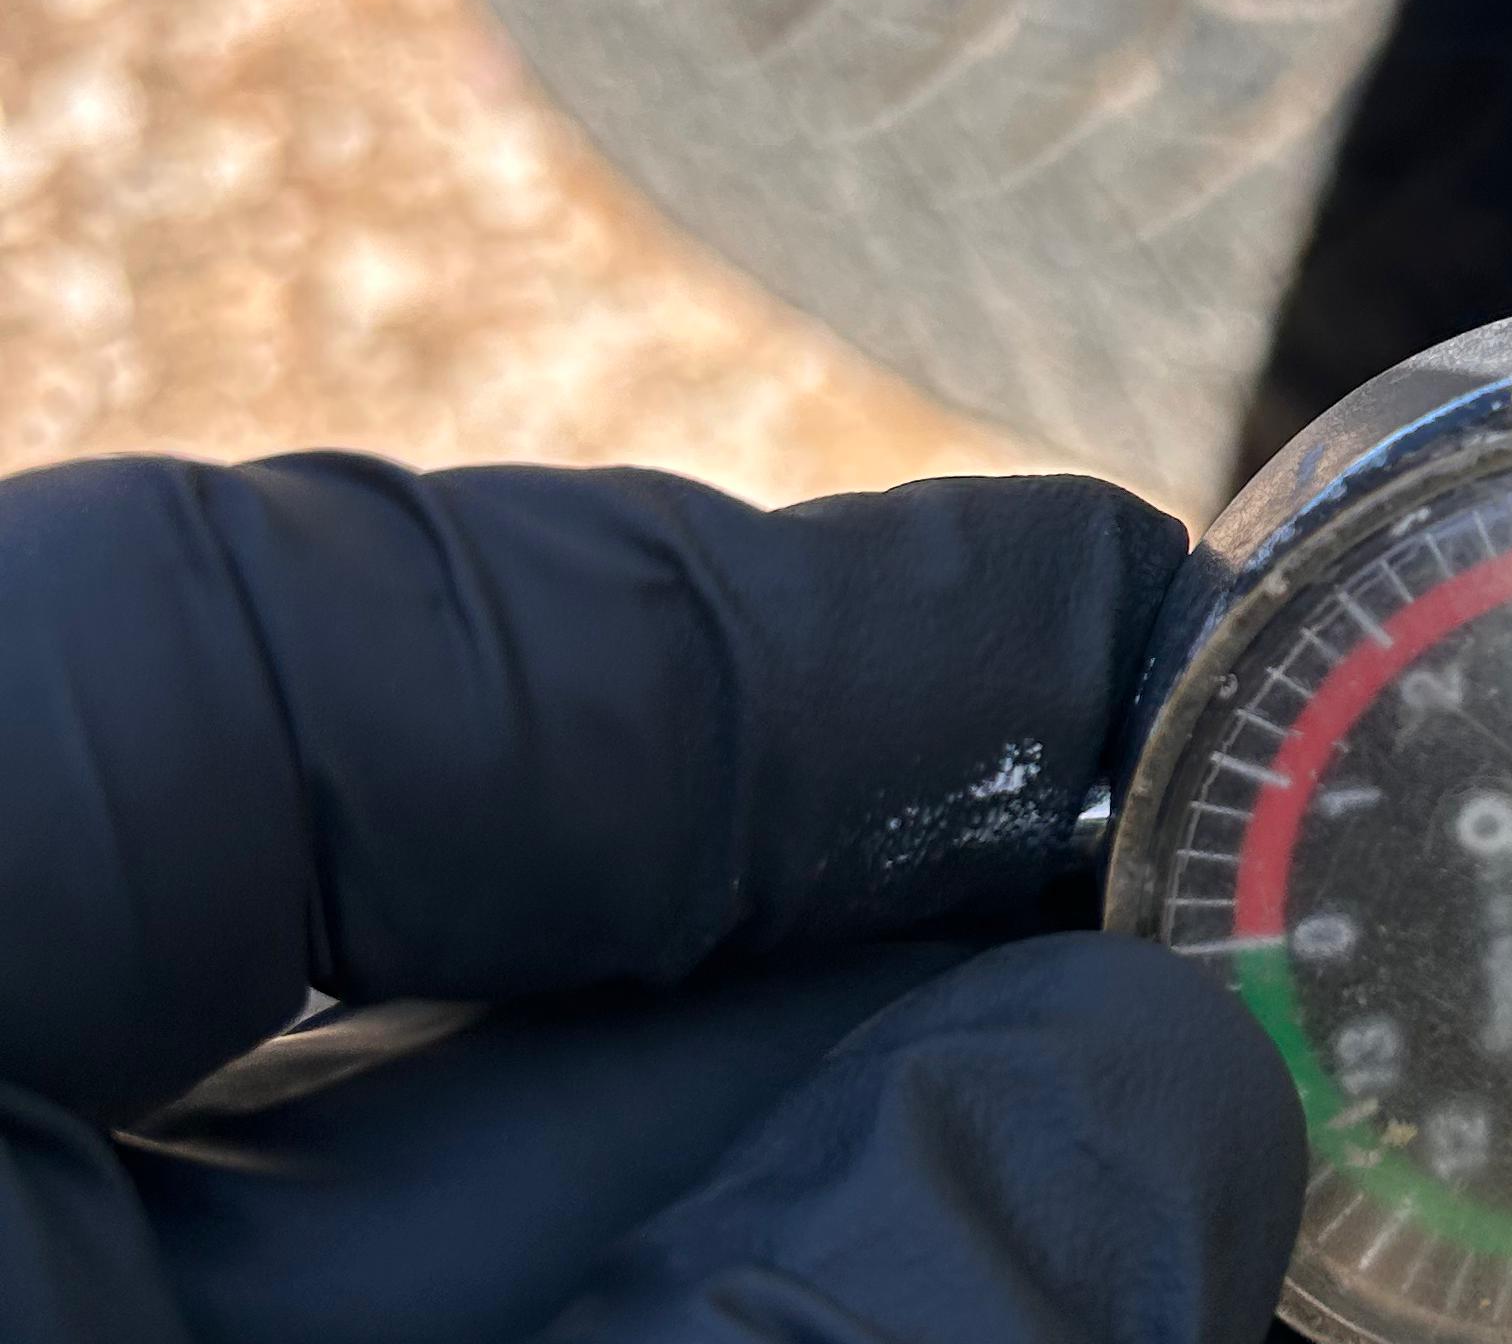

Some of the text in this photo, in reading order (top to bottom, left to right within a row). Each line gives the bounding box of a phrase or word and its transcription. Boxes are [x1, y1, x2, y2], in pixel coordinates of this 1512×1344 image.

[1401, 662, 1464, 707] 2
[1318, 785, 1382, 816] 1
[1294, 912, 1355, 955] 0
